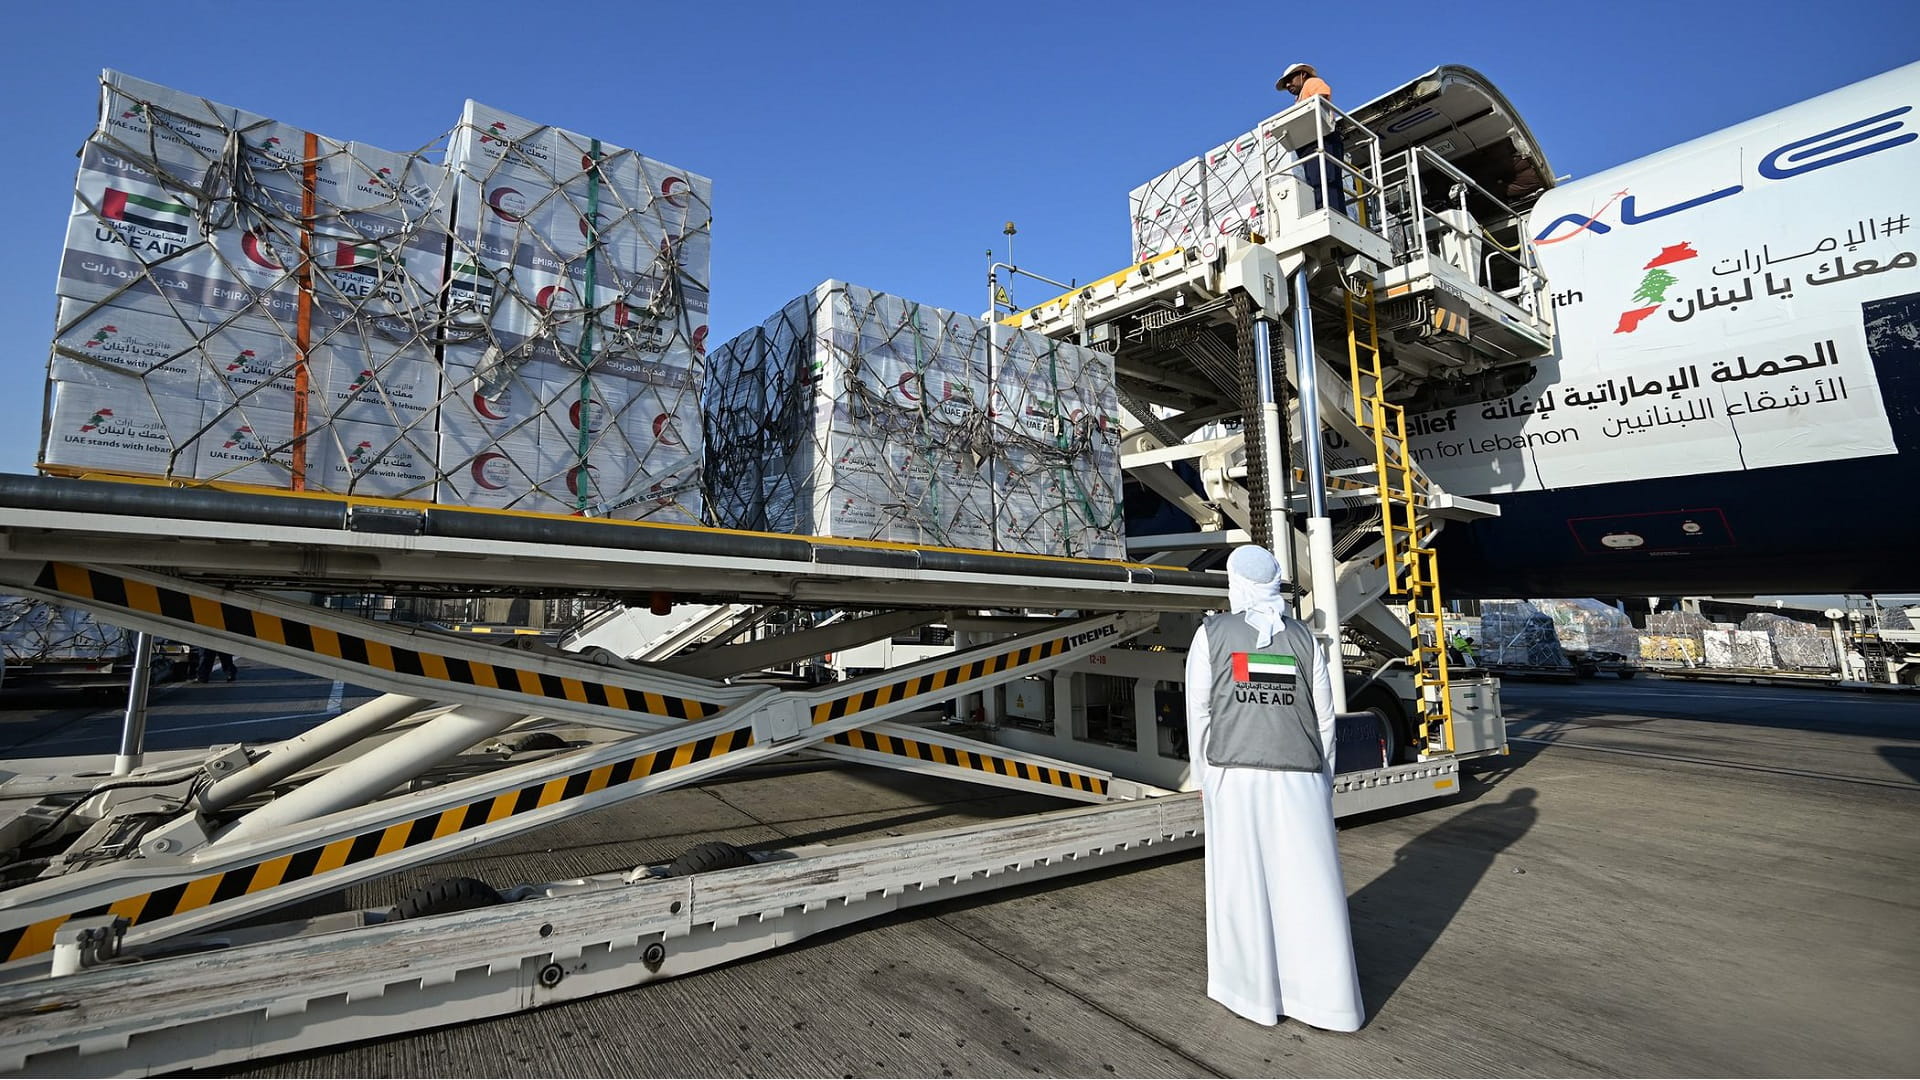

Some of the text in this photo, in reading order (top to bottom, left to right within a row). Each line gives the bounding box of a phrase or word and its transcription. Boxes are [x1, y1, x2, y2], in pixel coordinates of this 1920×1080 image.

[284, 202, 304, 215] GIF
[95, 227, 143, 250] UAE
[532, 257, 573, 273] EMIRATS
[1667, 250, 1919, 323] معك يا لبنان
[1550, 288, 1584, 310] ith
[126, 358, 148, 369] with
[150, 361, 188, 375] lbanon
[1481, 339, 1840, 420] الحملة الإماراتية لإغاثة
[399, 401, 428, 412] lebanon
[1602, 375, 1849, 438] الأشقاء اللبنانيين
[64, 434, 184, 456] UAE stands with lebann
[1436, 440, 1465, 459] for
[1469, 426, 1580, 455] Lebanon
[209, 450, 229, 460] UAE
[378, 469, 396, 478] with
[396, 471, 427, 481] lebanon
[1069, 623, 1119, 649] TREPEL
[1235, 690, 1296, 706] UAE AID
